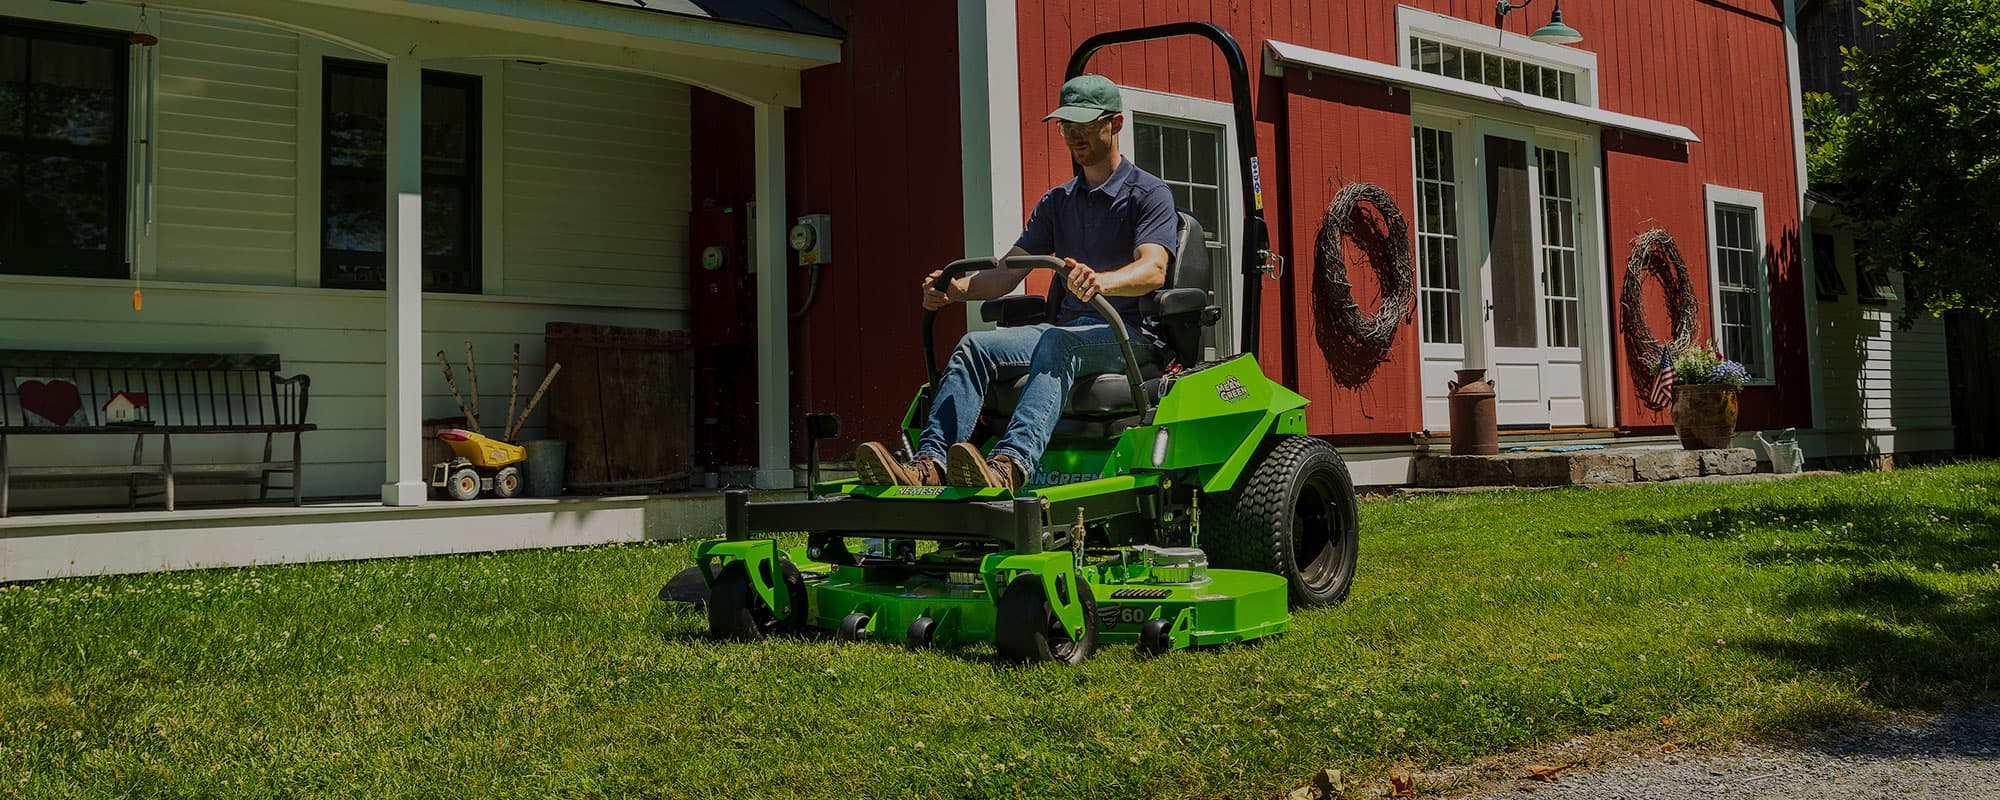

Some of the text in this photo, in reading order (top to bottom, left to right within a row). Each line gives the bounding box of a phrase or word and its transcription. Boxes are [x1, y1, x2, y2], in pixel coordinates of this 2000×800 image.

[1216, 379, 1240, 393] MEAN
[1220, 387, 1248, 400] GREEN
[961, 463, 973, 487] REL
[896, 487, 945, 495] NEMESIS
[1121, 608, 1144, 623] 60
